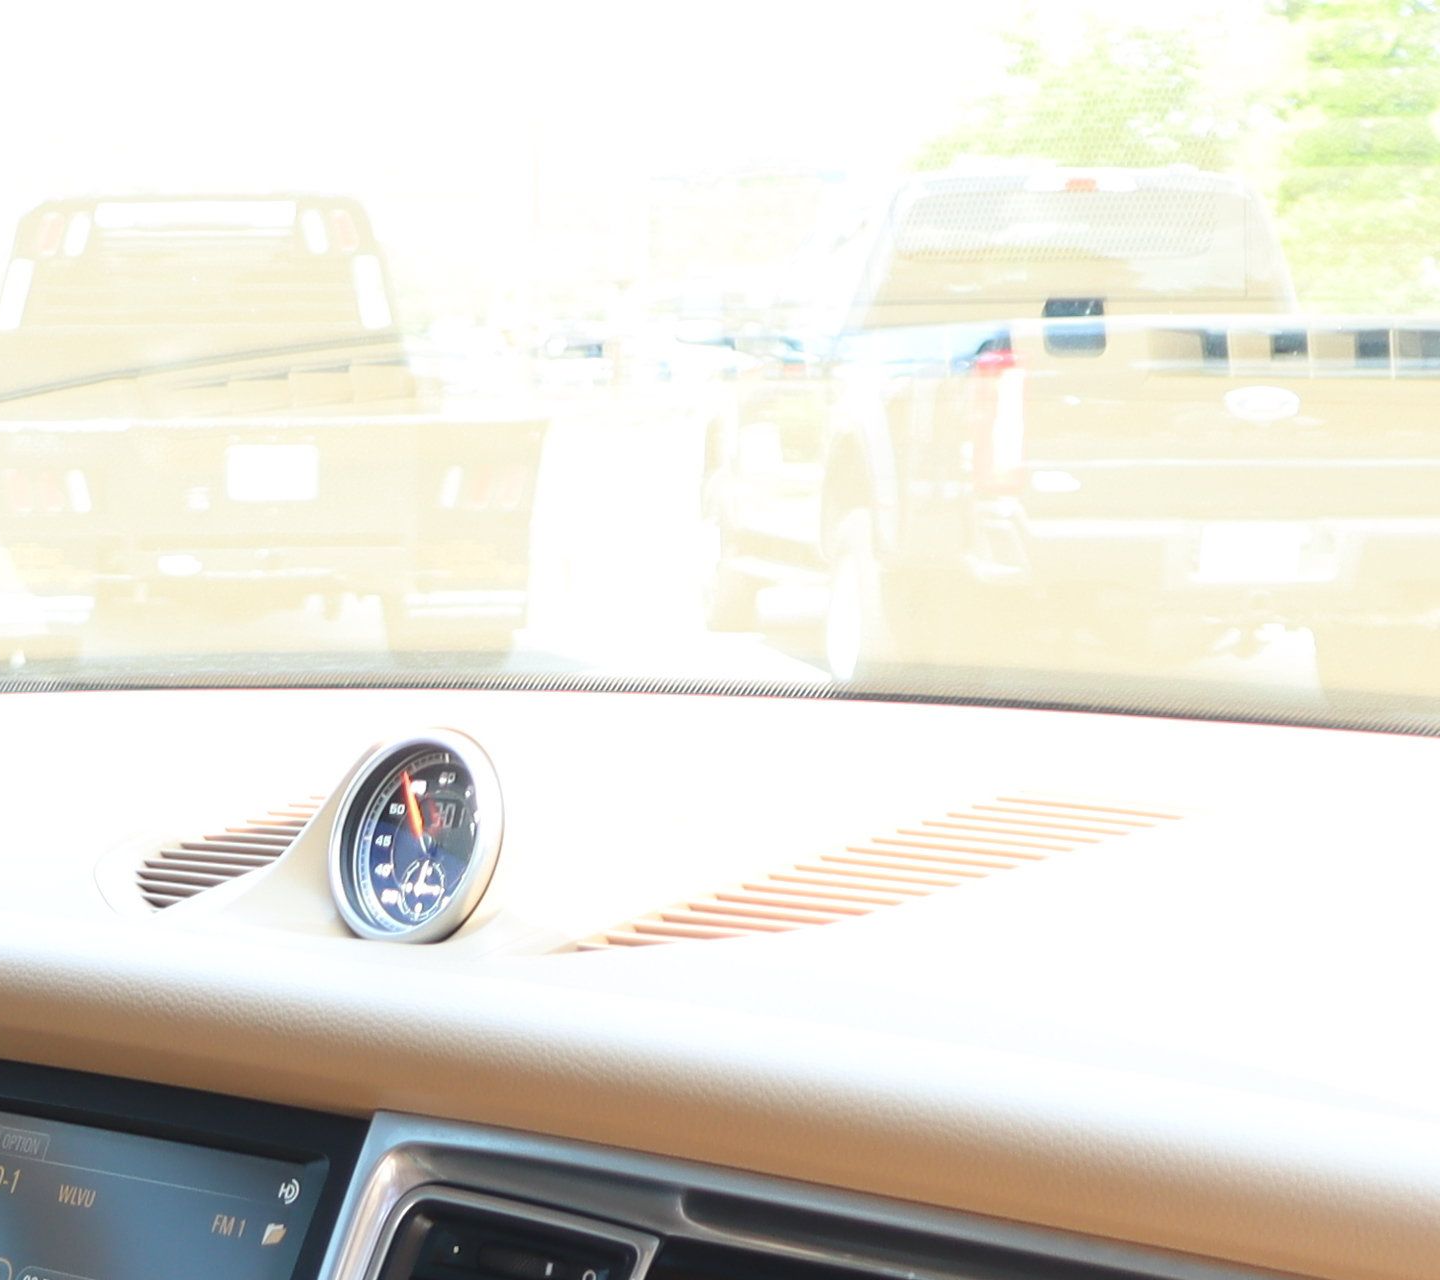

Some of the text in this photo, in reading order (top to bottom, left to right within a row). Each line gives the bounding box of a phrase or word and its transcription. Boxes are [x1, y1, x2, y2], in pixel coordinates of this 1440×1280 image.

[1, 1133, 42, 1154] OPTION
[58, 1184, 97, 1208] WLVU
[211, 1214, 247, 1238] FM 1
